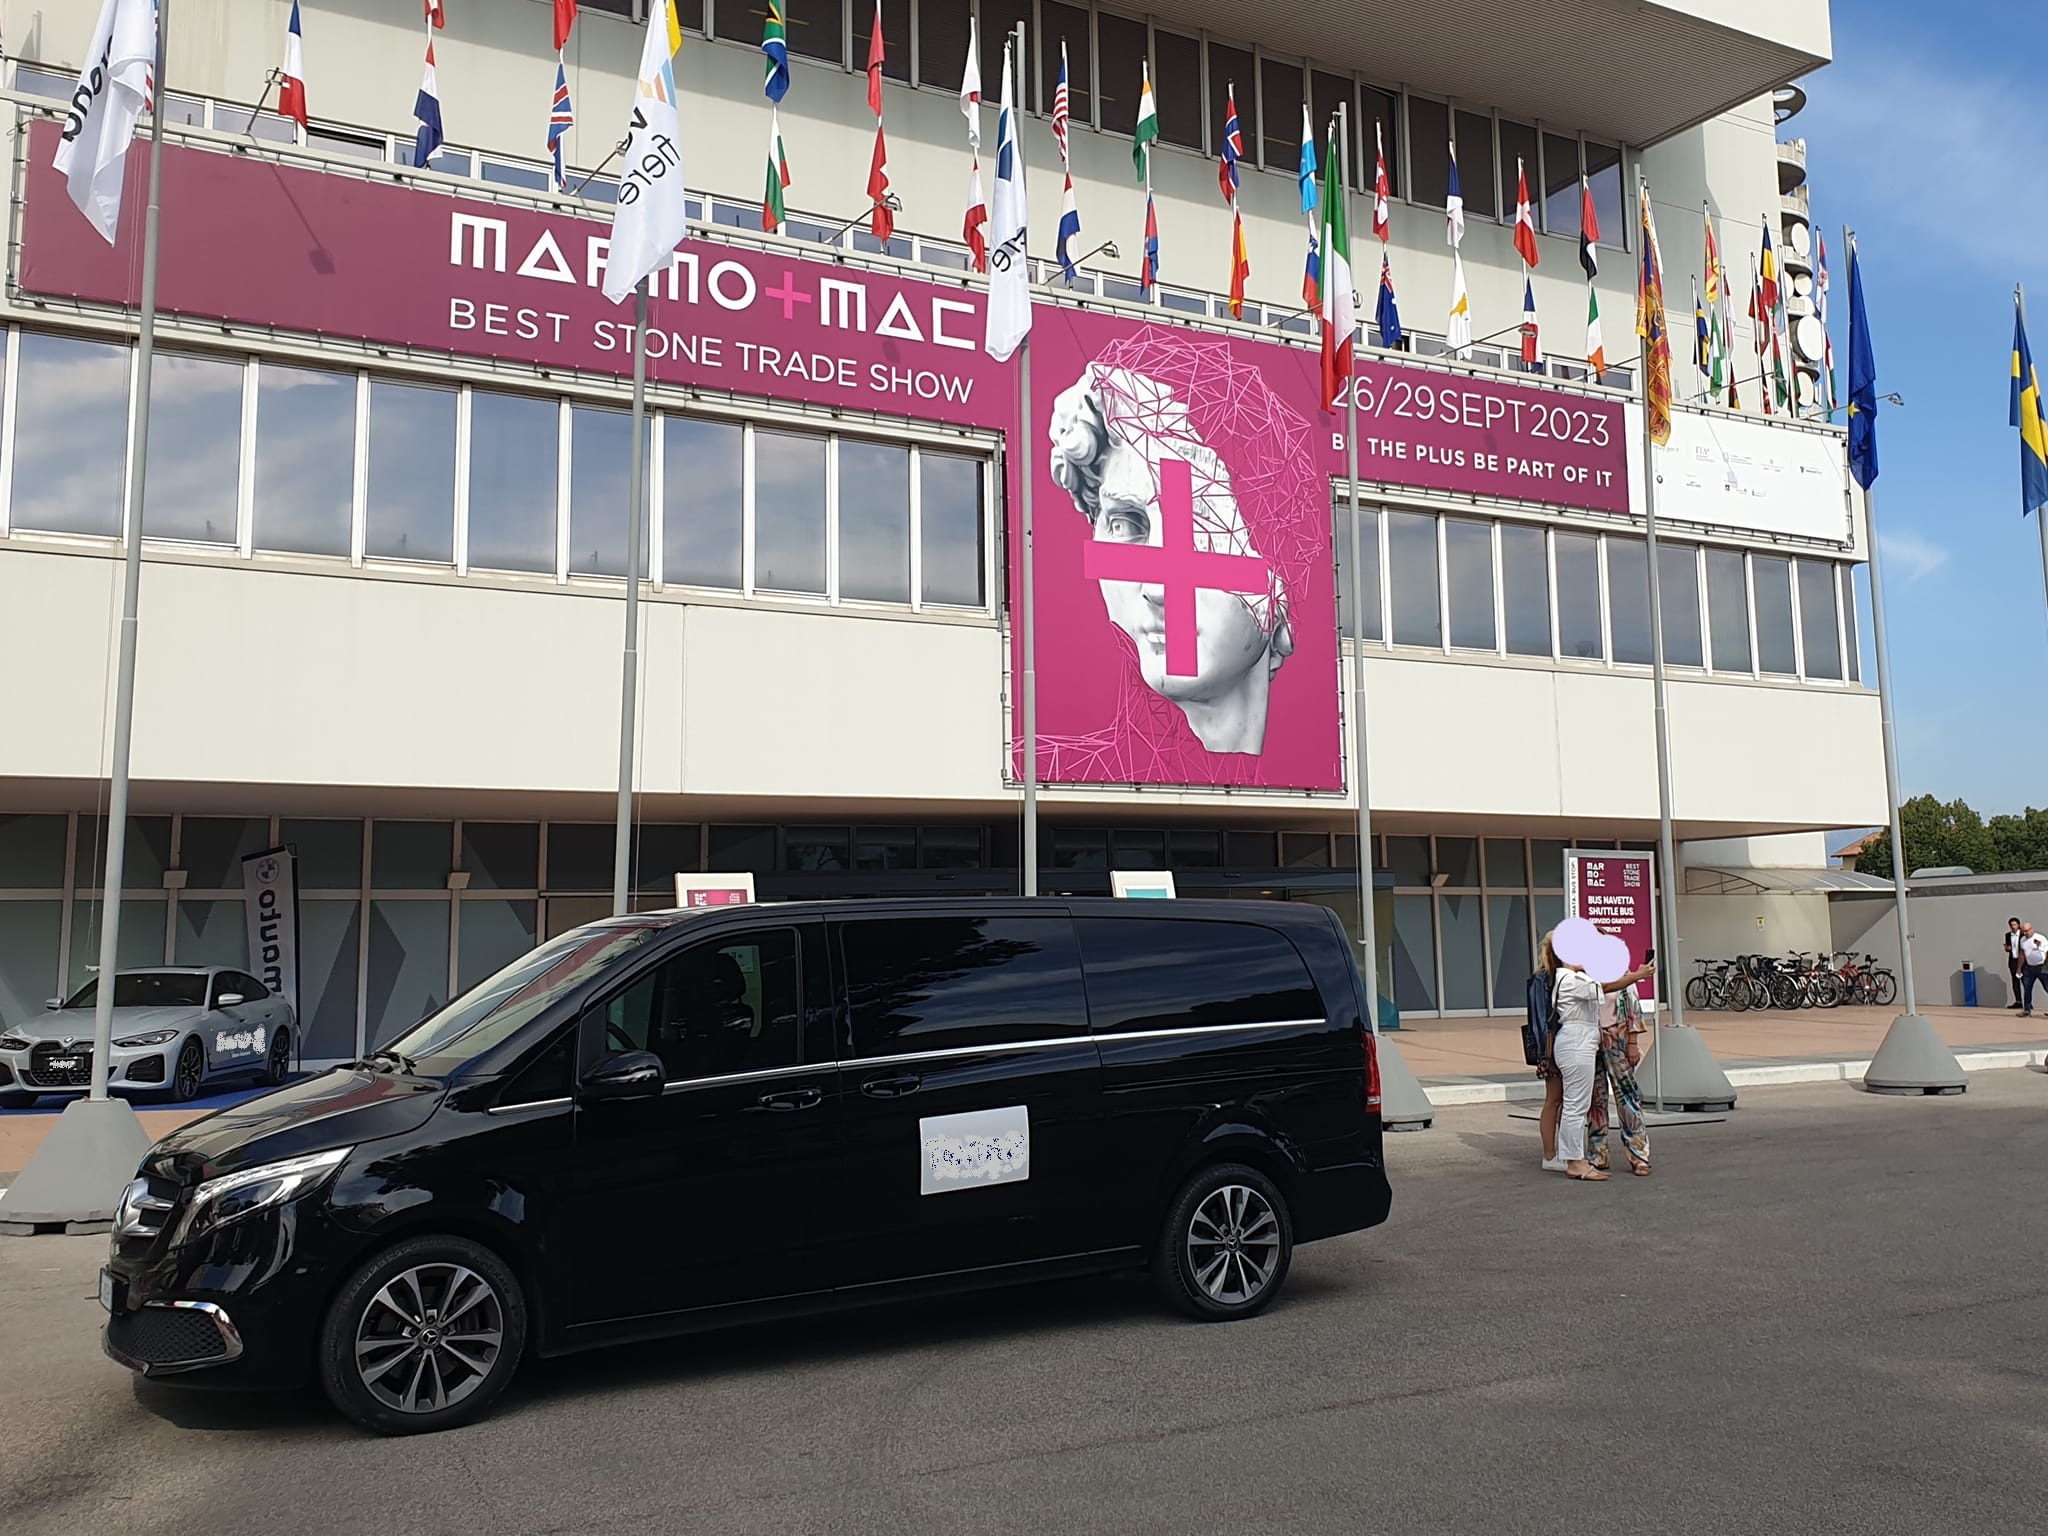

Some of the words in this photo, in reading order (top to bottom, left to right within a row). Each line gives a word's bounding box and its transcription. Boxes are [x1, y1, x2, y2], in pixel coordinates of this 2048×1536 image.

[450, 297, 570, 343] BEST
[593, 320, 723, 367] STONE
[735, 341, 858, 388] TRADE
[869, 363, 975, 404] SHOW
[1331, 432, 1350, 450] B
[1366, 437, 1407, 459] THE
[1415, 444, 1466, 467] PLUS
[1473, 452, 1499, 472] BE
[1506, 457, 1556, 480] PART
[1563, 465, 1589, 484] OF
[1596, 470, 1613, 488] IT
[1588, 896, 1602, 904] BUS
[1603, 896, 1634, 904] NAVETTA
[1588, 906, 1619, 916] SHUTTLE
[1619, 907, 1634, 916] BUS
